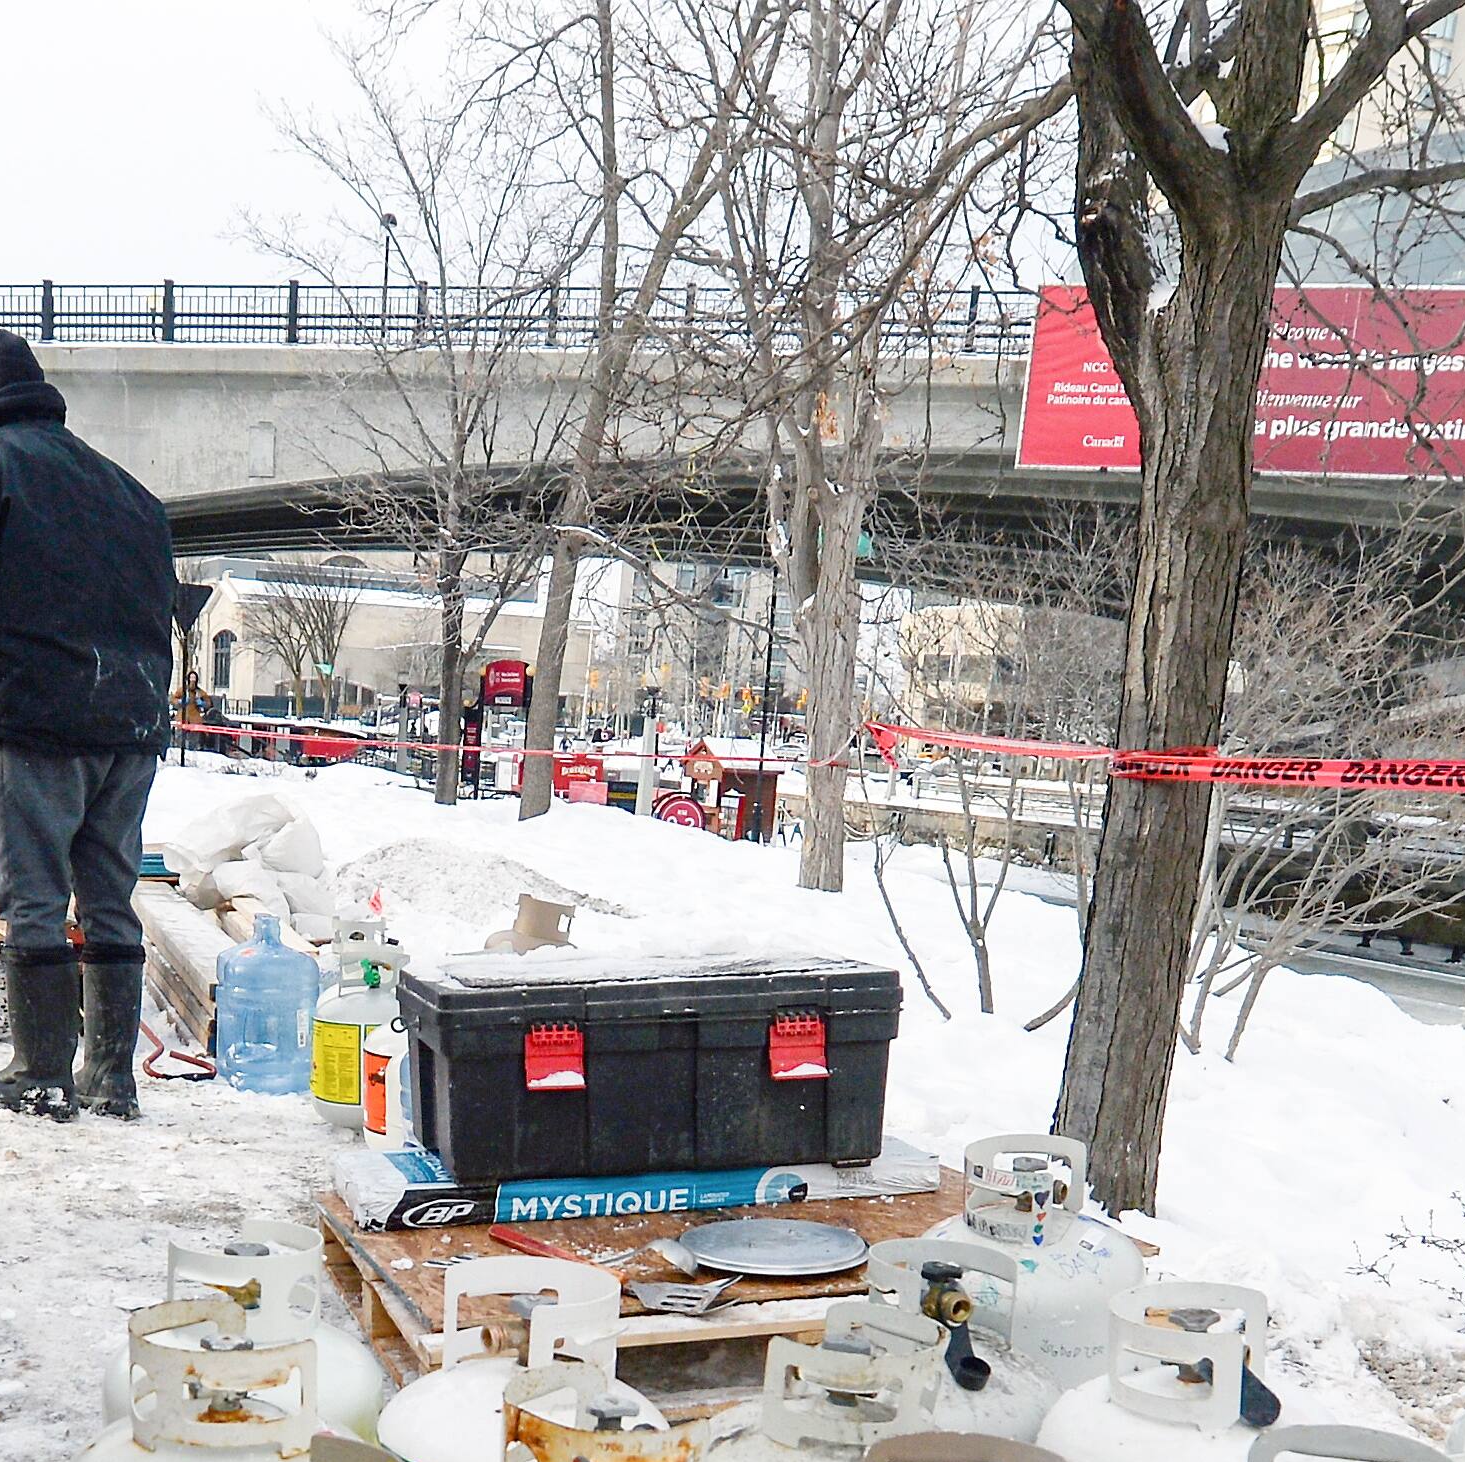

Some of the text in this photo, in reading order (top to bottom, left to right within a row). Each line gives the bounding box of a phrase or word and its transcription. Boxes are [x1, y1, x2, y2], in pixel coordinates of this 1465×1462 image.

[1083, 362, 1109, 373] NCC
[1053, 382, 1119, 393] Rideau Canal
[1046, 394, 1091, 405] Patinoire
[1092, 394, 1107, 405] du
[1270, 415, 1321, 440] plus
[1324, 418, 1410, 443] grande
[1209, 761, 1324, 782] DANGER
[417, 1187, 690, 1225] BP MYSTIQUE
